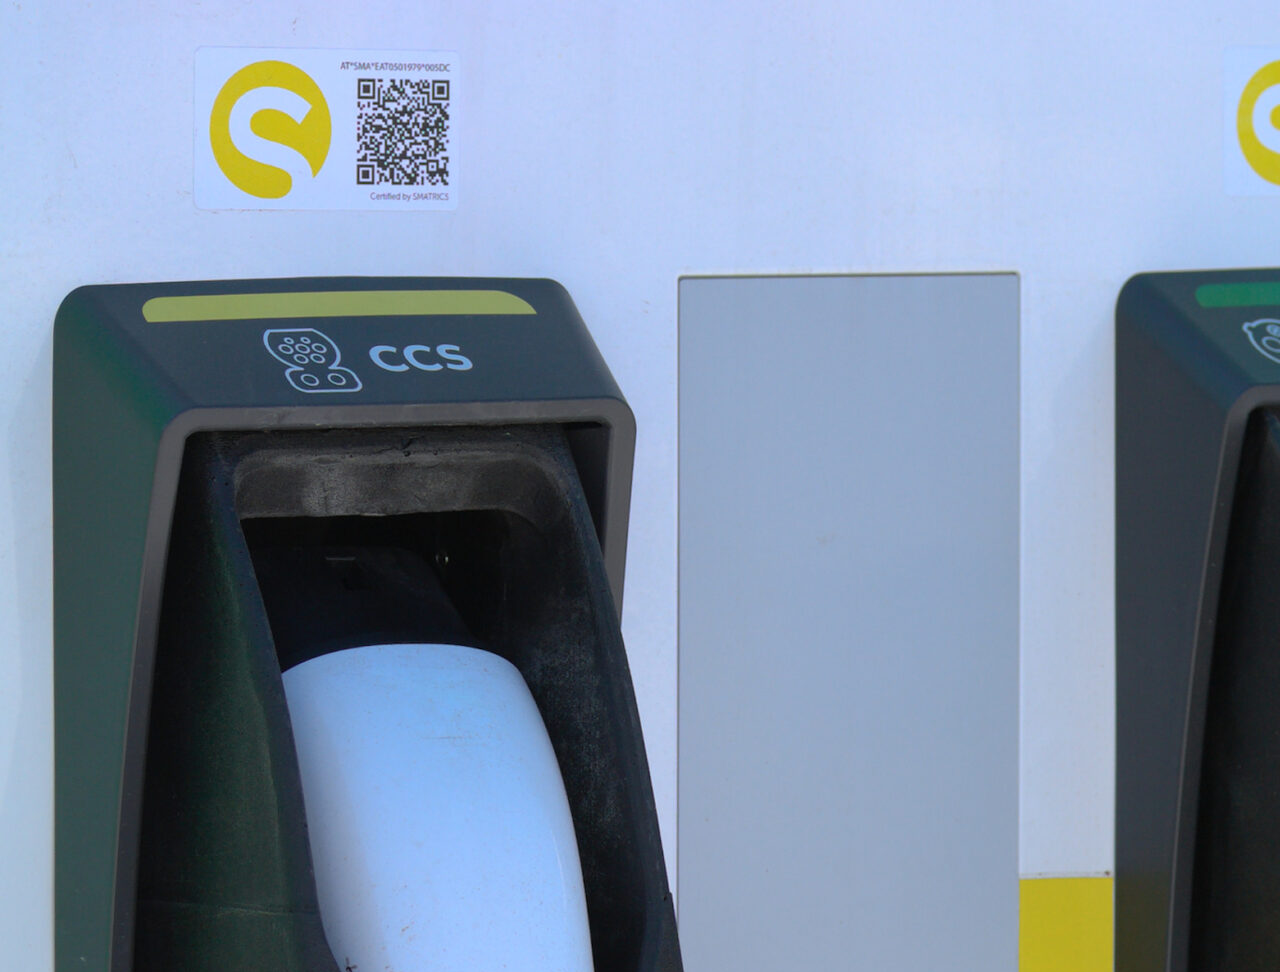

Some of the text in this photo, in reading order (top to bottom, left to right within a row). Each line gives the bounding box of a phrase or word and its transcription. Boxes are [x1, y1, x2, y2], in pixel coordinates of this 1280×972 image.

[370, 191, 449, 203] Certified by SMATRICS
[369, 344, 473, 373] CCS
